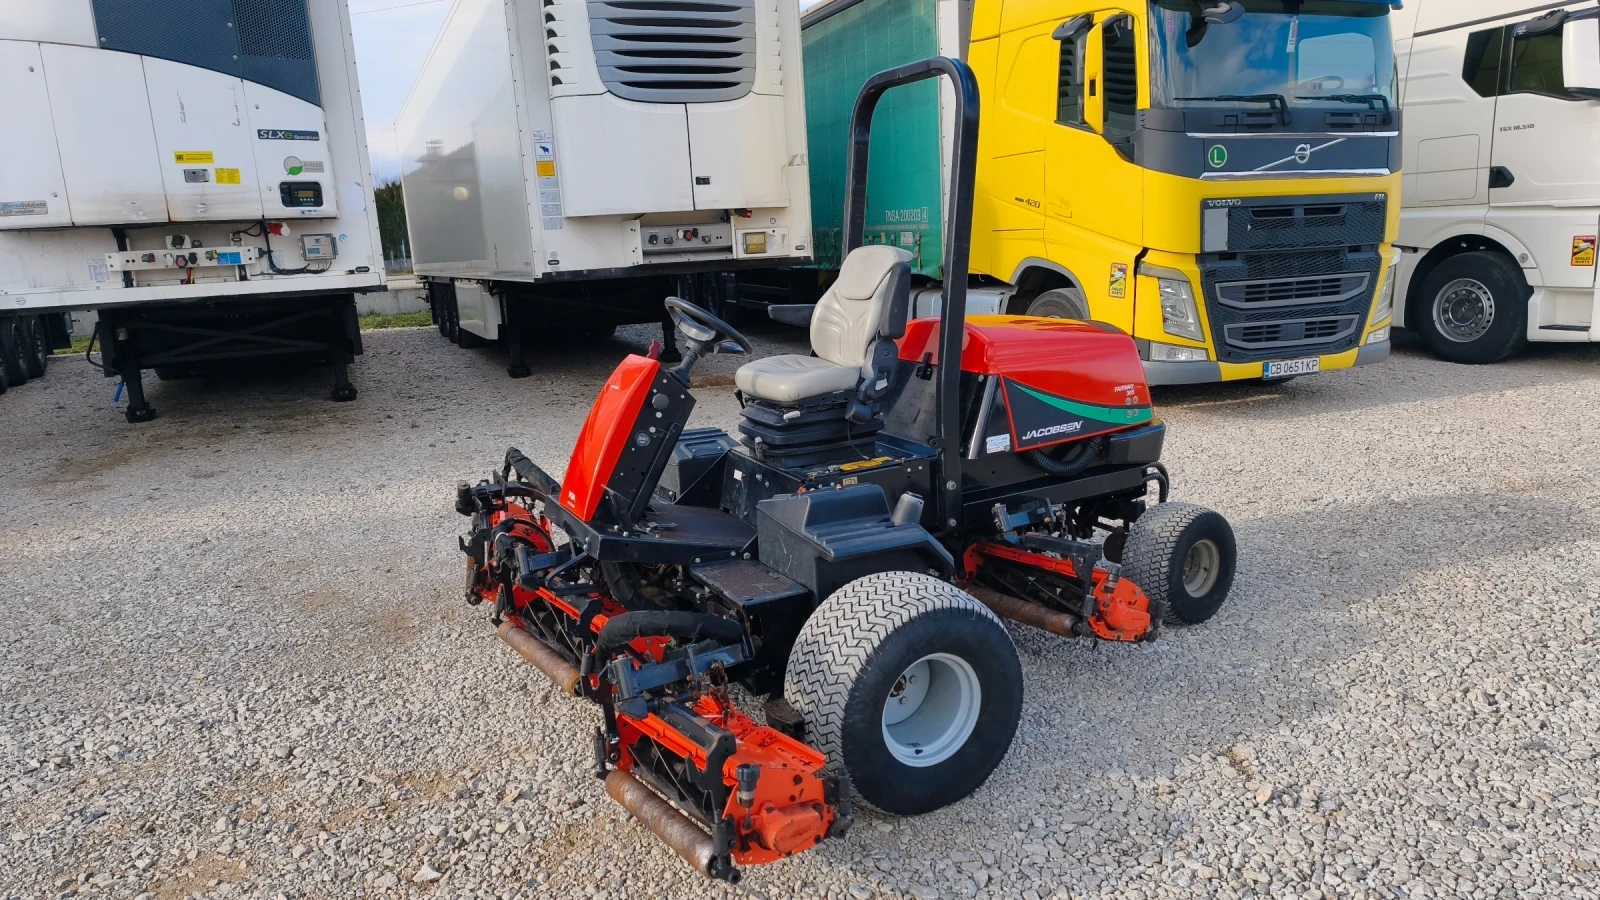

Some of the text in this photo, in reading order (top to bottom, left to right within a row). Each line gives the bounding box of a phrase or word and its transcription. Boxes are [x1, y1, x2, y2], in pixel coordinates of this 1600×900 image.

[1513, 123, 1535, 131] 18.510
[259, 130, 293, 139] SLXe
[1214, 149, 1222, 164] L
[1025, 197, 1041, 209] 420
[1207, 198, 1242, 207] VOLVO
[885, 209, 900, 221] TNSA
[900, 208, 921, 221] 200203
[1270, 359, 1318, 375] CB 0651 KP
[1114, 383, 1135, 393] FAIRWAY
[1022, 421, 1083, 440] JACOBSEN
